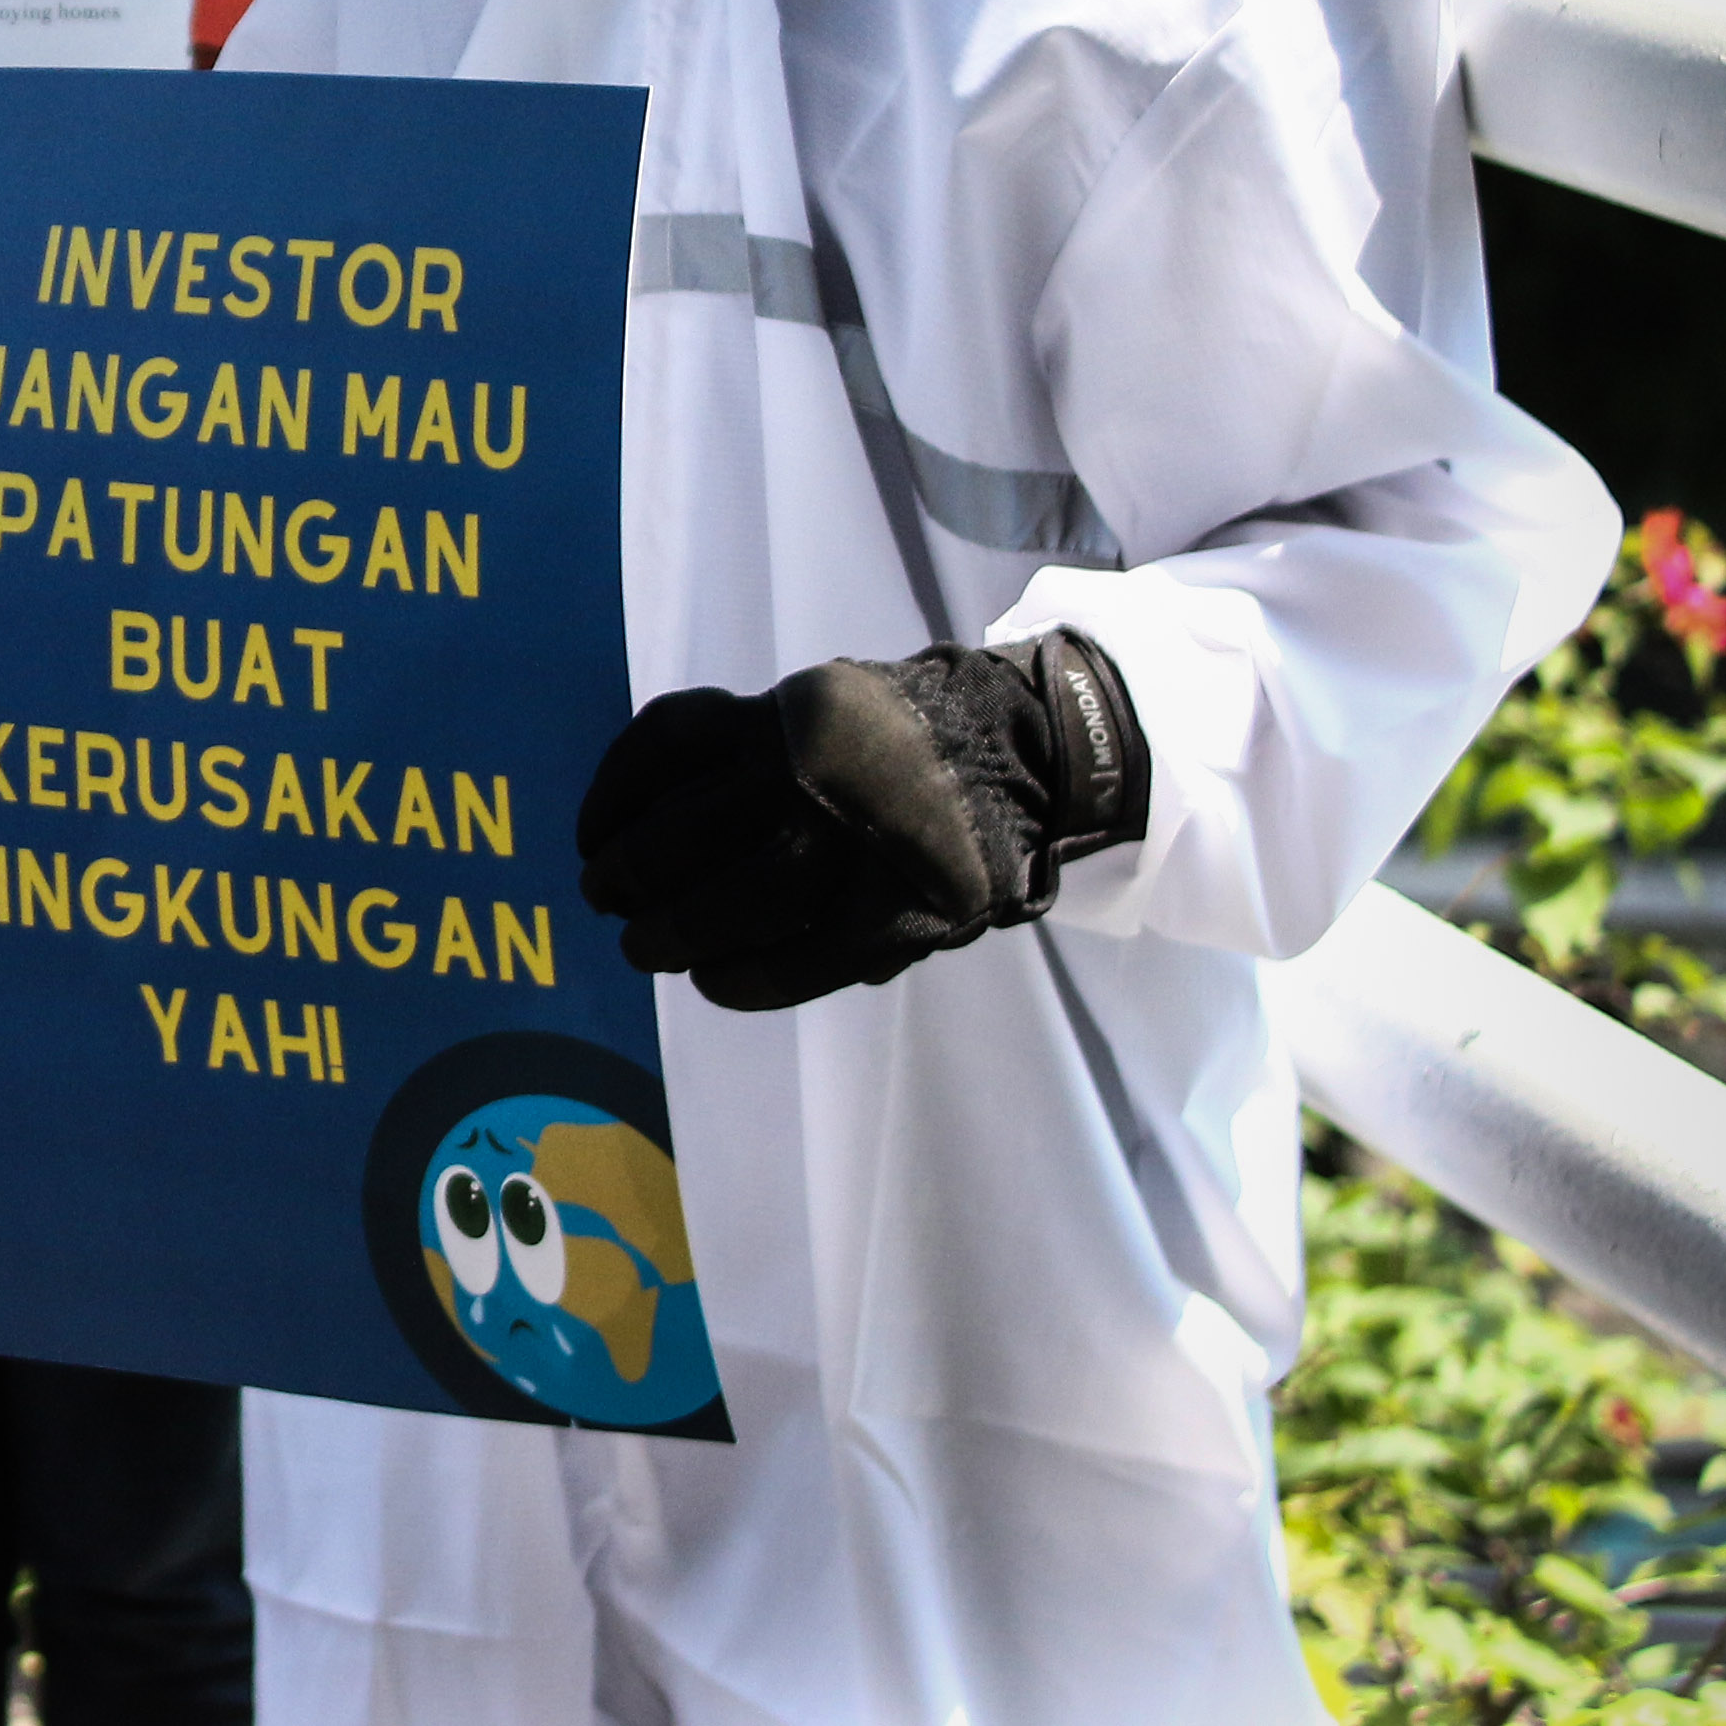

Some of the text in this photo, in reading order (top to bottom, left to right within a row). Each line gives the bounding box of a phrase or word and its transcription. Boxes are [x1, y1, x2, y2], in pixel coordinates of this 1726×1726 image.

[59, 5, 121, 20] homes
[38, 224, 463, 332] INVESTOR
[342, 372, 529, 469] MAU
[111, 610, 342, 711] BUAT
[1066, 670, 1112, 765] MONDAY
